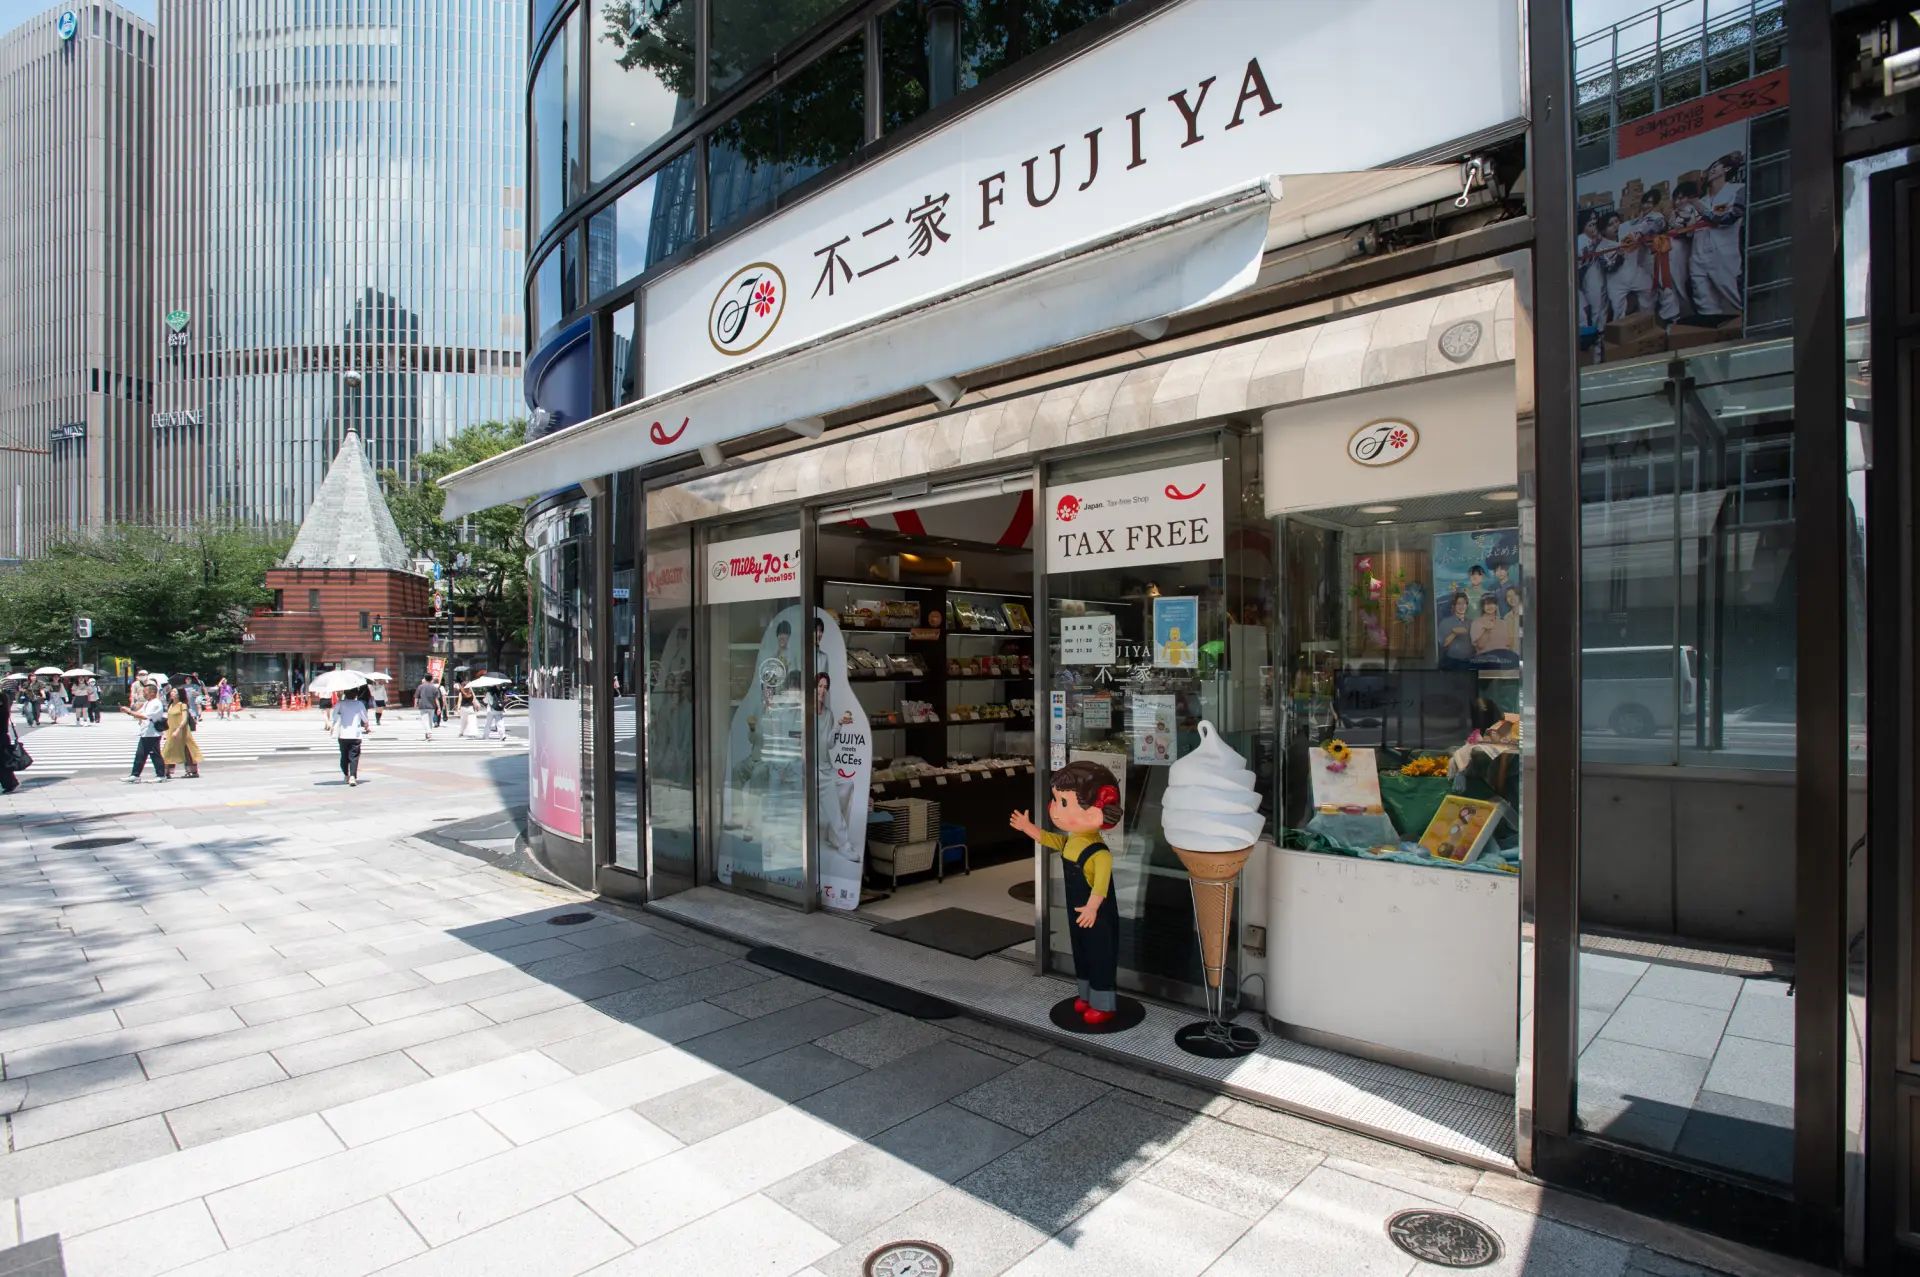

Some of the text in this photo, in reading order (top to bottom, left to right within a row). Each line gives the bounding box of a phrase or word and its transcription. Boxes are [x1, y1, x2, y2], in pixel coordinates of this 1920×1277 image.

[811, 57, 1283, 300] 不二家 FUJIYA
[151, 409, 203, 428] LUMINE
[1132, 496, 1150, 504] Shop
[1058, 517, 1209, 558] TAX FREE
[730, 556, 764, 584] Milky
[1116, 645, 1151, 658] JIYA
[1094, 663, 1153, 684] 不二家
[833, 733, 866, 746] FUJIYA
[834, 753, 862, 766] ACEes
